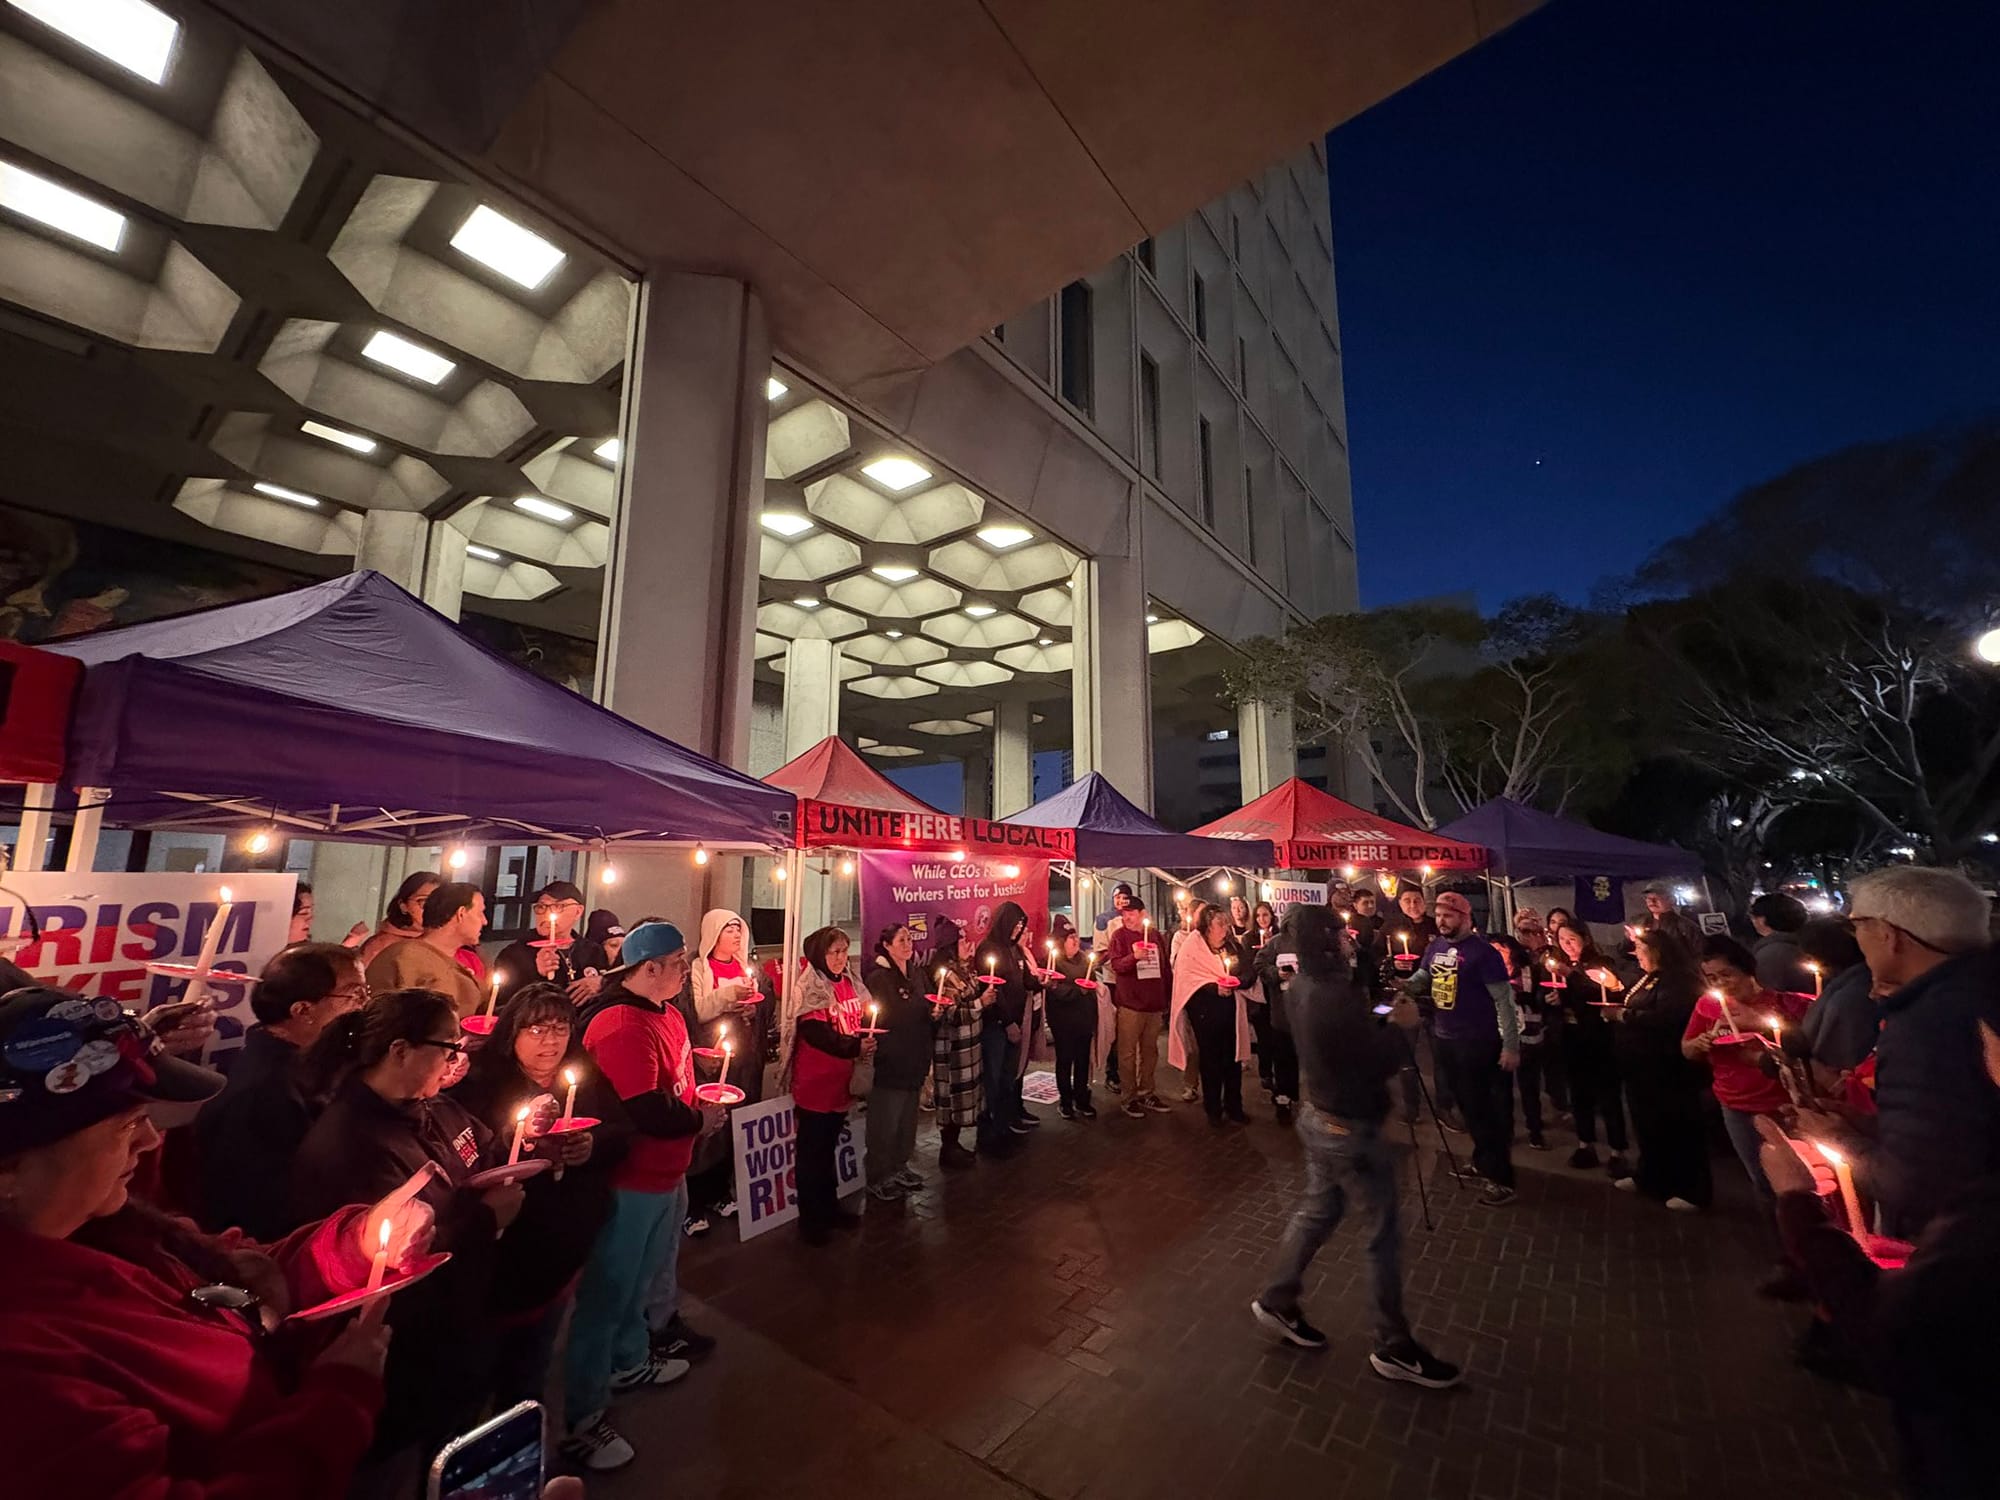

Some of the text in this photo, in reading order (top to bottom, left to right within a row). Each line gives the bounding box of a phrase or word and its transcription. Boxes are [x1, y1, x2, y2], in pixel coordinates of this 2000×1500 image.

[973, 820, 1053, 848] LOCAL
[1056, 831, 1071, 850] 11
[1398, 846, 1467, 861] LOCAL
[912, 863, 947, 880] While
[950, 865, 980, 879] CEOs
[893, 885, 944, 903] Workers
[947, 885, 971, 900] Fast
[974, 884, 990, 898] for
[1269, 887, 1322, 903] OURISM
